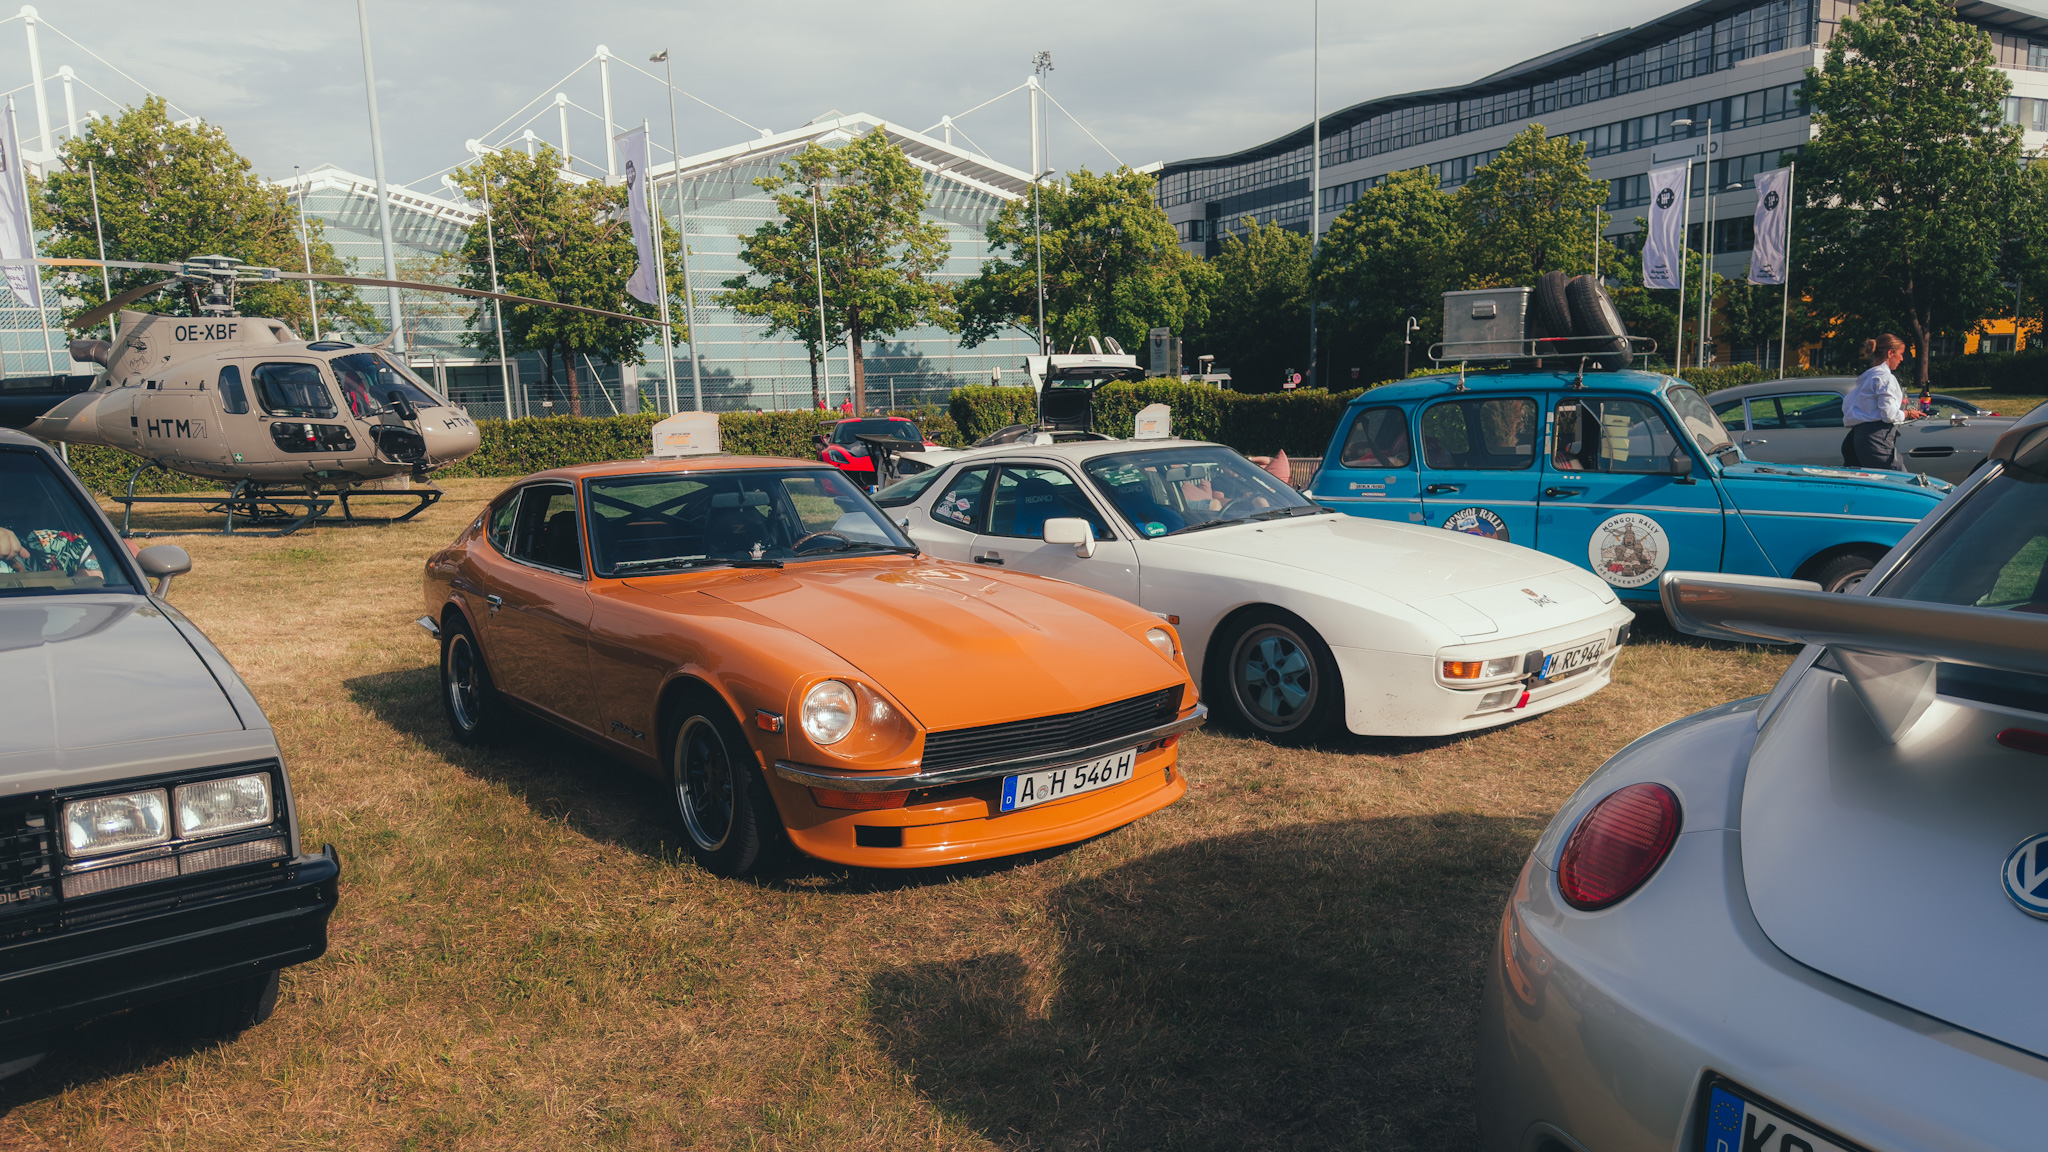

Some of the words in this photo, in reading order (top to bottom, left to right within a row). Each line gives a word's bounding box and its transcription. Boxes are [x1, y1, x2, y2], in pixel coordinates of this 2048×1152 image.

[175, 323, 238, 342] OE-XBF
[147, 418, 191, 438] HTM
[1025, 494, 1053, 504] RECARO
[1443, 507, 1477, 530] MONGOL
[1479, 508, 1506, 531] RALLY
[1602, 516, 1635, 532] MONGOL
[1638, 518, 1660, 534] RALLY
[1596, 563, 1607, 576] THE
[1608, 567, 1659, 585] ADVENTURISTS
[1546, 655, 1560, 675] M
[1561, 649, 1581, 671] RC
[1021, 777, 1034, 803] A
[1050, 770, 1067, 796] H
